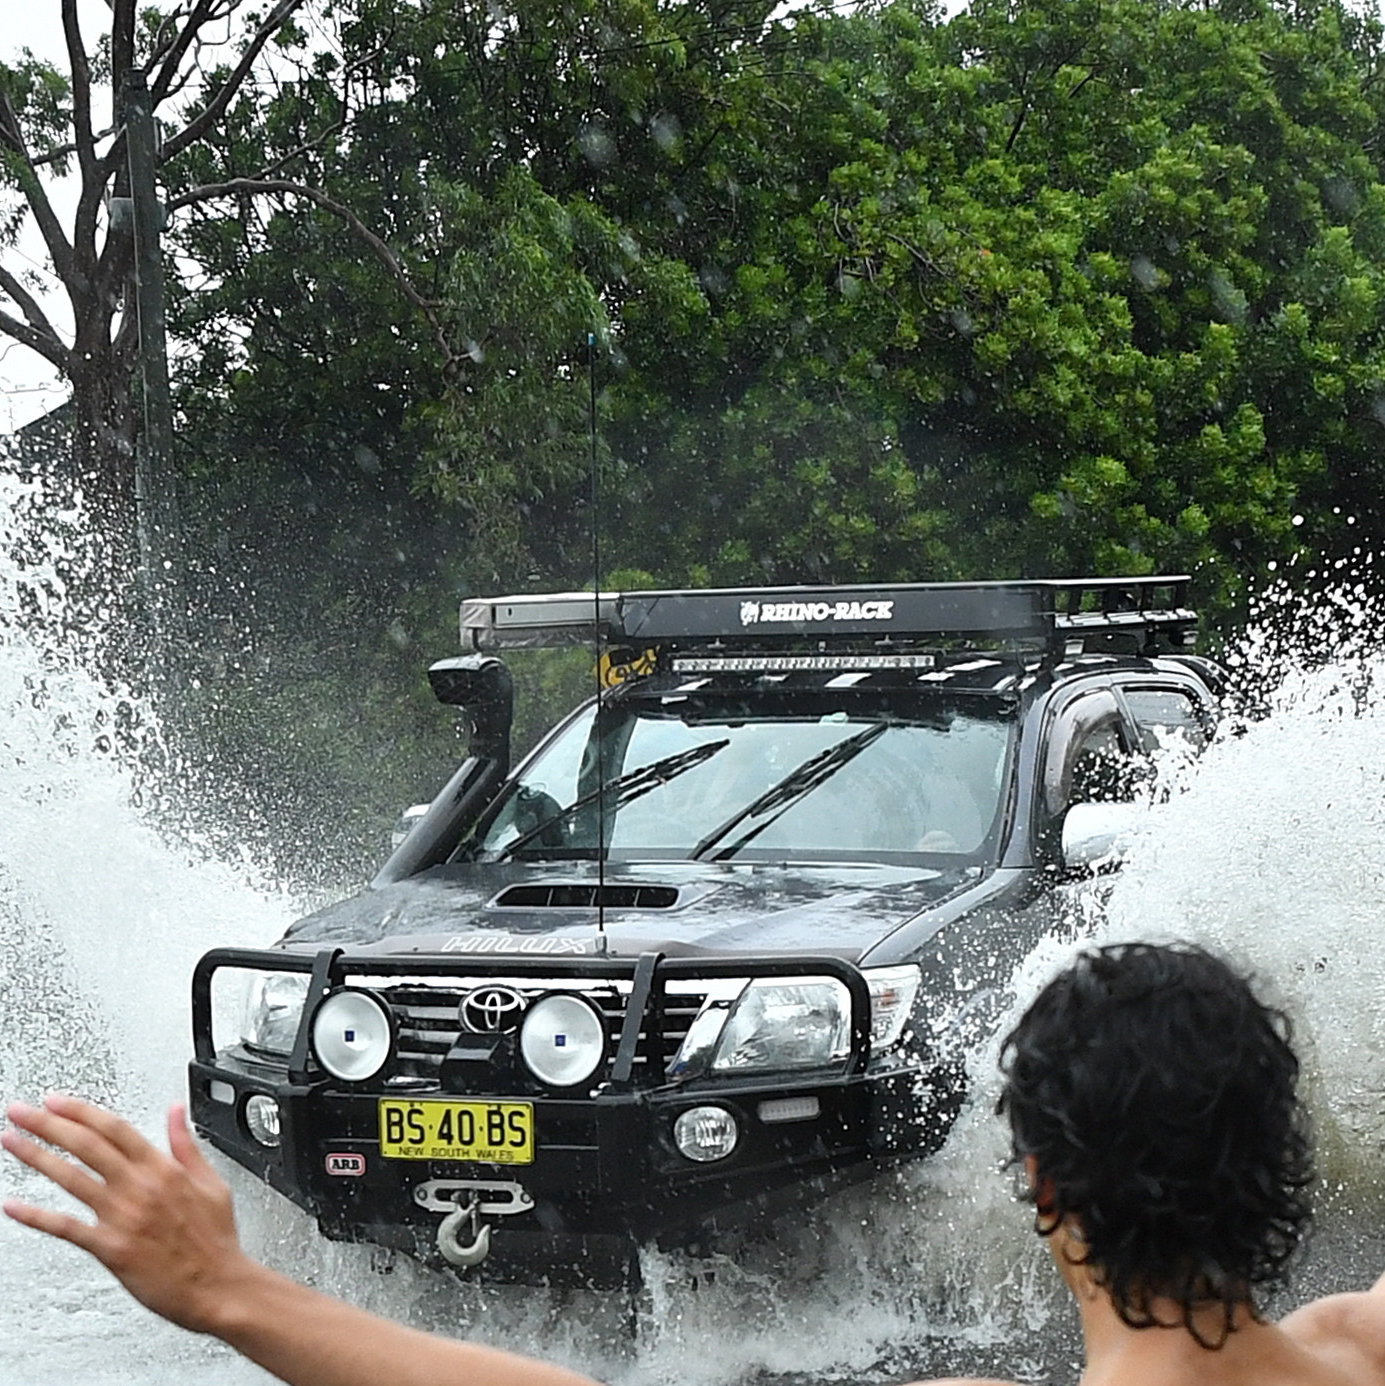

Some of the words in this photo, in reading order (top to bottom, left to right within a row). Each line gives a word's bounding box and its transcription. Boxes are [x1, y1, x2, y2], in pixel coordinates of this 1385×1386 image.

[760, 601, 894, 622] RHINO-RACK
[440, 936, 592, 954] HILUX
[398, 1147, 425, 1156] NEW
[431, 1148, 470, 1158] SOUTH
[477, 1149, 514, 1160] WALES
[331, 1158, 360, 1170] ARB
